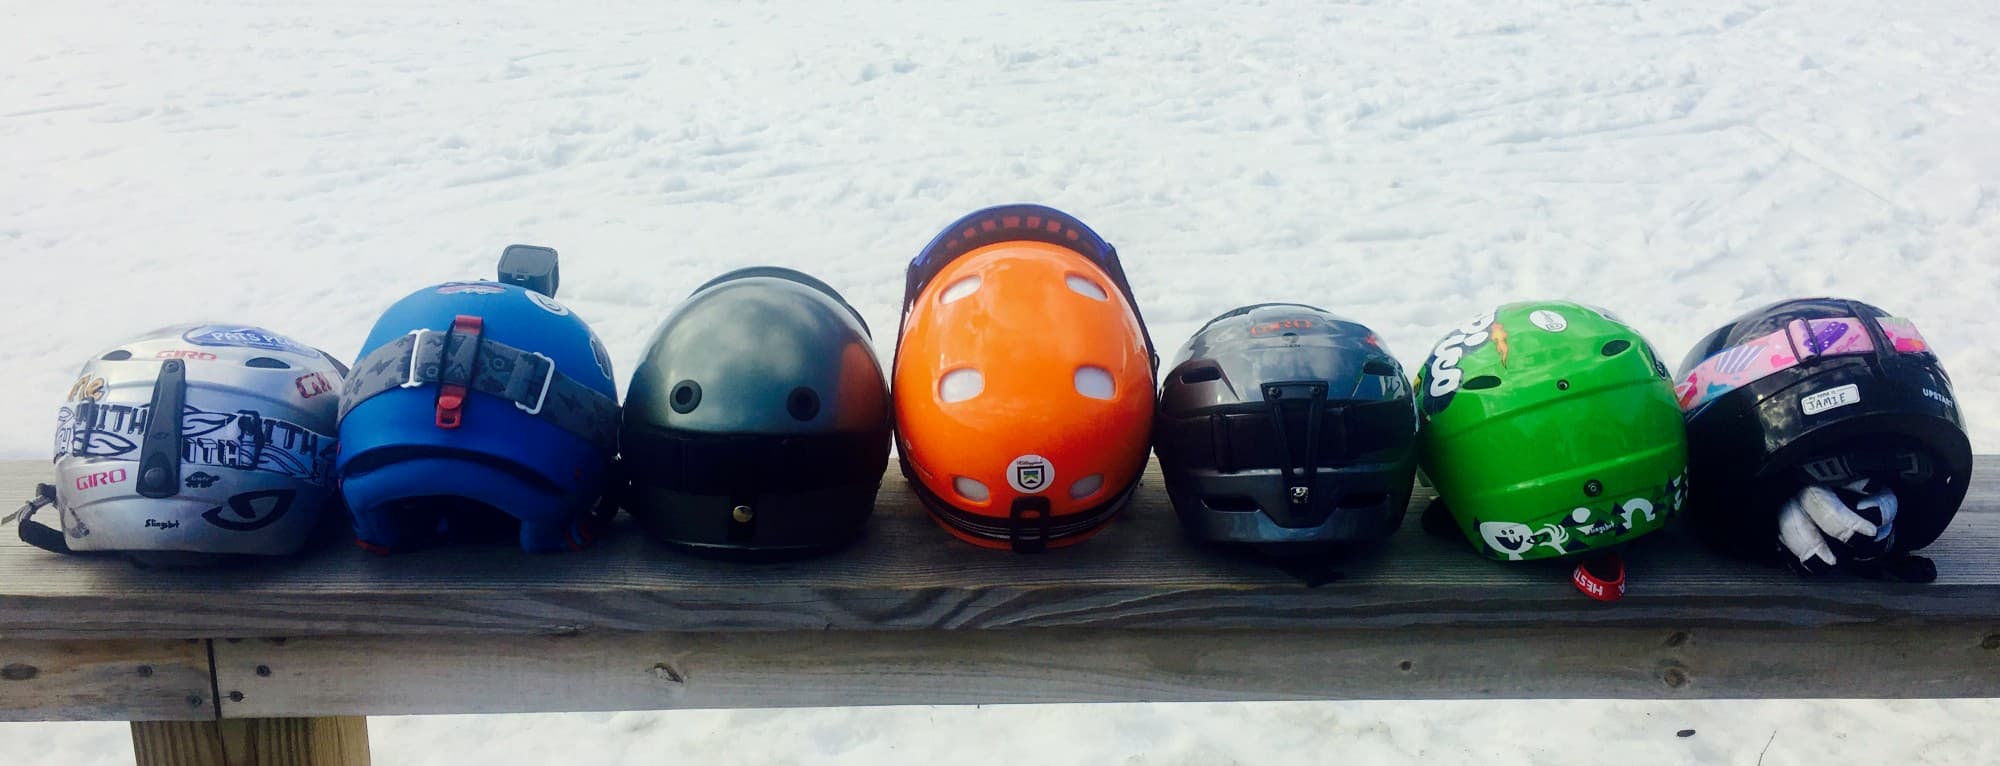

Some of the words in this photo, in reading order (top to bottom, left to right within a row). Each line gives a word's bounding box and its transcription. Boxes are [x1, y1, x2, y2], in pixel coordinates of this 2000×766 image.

[1250, 319, 1312, 336] GIRO
[211, 331, 260, 343] PATS
[155, 350, 216, 362] GIRO
[1806, 392, 1847, 410] JAMIE
[1922, 387, 1954, 409] UPSTART
[75, 468, 127, 491] GIRO
